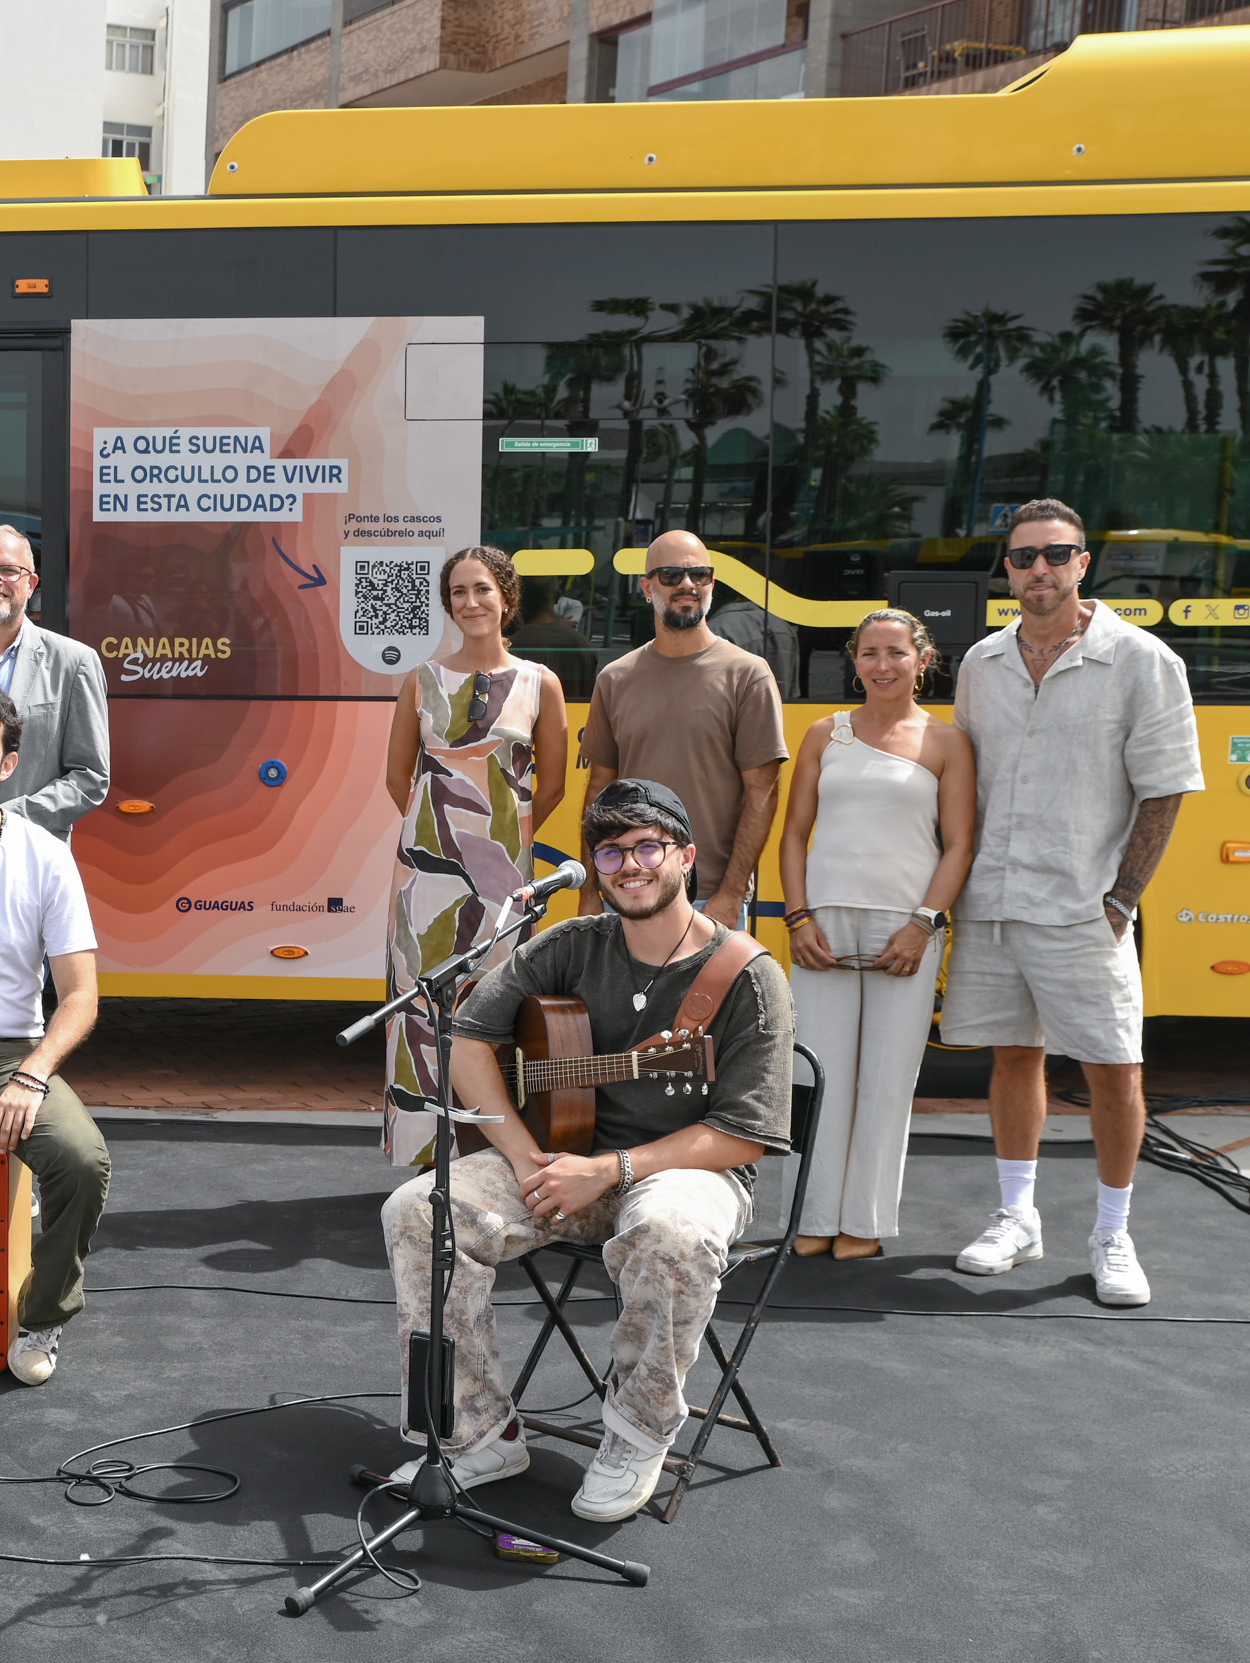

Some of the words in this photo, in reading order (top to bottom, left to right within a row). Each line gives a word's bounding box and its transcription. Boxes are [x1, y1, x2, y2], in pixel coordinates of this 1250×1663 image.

[99, 435, 127, 459] ¿A
[132, 430, 181, 455] QUÉ
[188, 435, 265, 454] SUENA
[99, 465, 125, 484] EL
[130, 465, 239, 484] ORGULLO
[246, 465, 276, 484] DE
[282, 465, 343, 484] VIVIR
[99, 493, 128, 512] EN
[136, 493, 190, 512] ESTA
[196, 493, 297, 512] CIUDAD?
[344, 513, 380, 525] ¡Ponte
[383, 513, 400, 523] los
[402, 515, 442, 523] cascos
[343, 529, 350, 539] y
[353, 528, 415, 538] descúbrelo
[417, 528, 445, 540] aquí!
[924, 609, 952, 617] Gas-oil
[1114, 607, 1147, 616] com
[100, 636, 232, 659] CANARIAS
[120, 652, 209, 682] Suena
[193, 899, 255, 912] GUAGUAS
[270, 901, 325, 913] fundación
